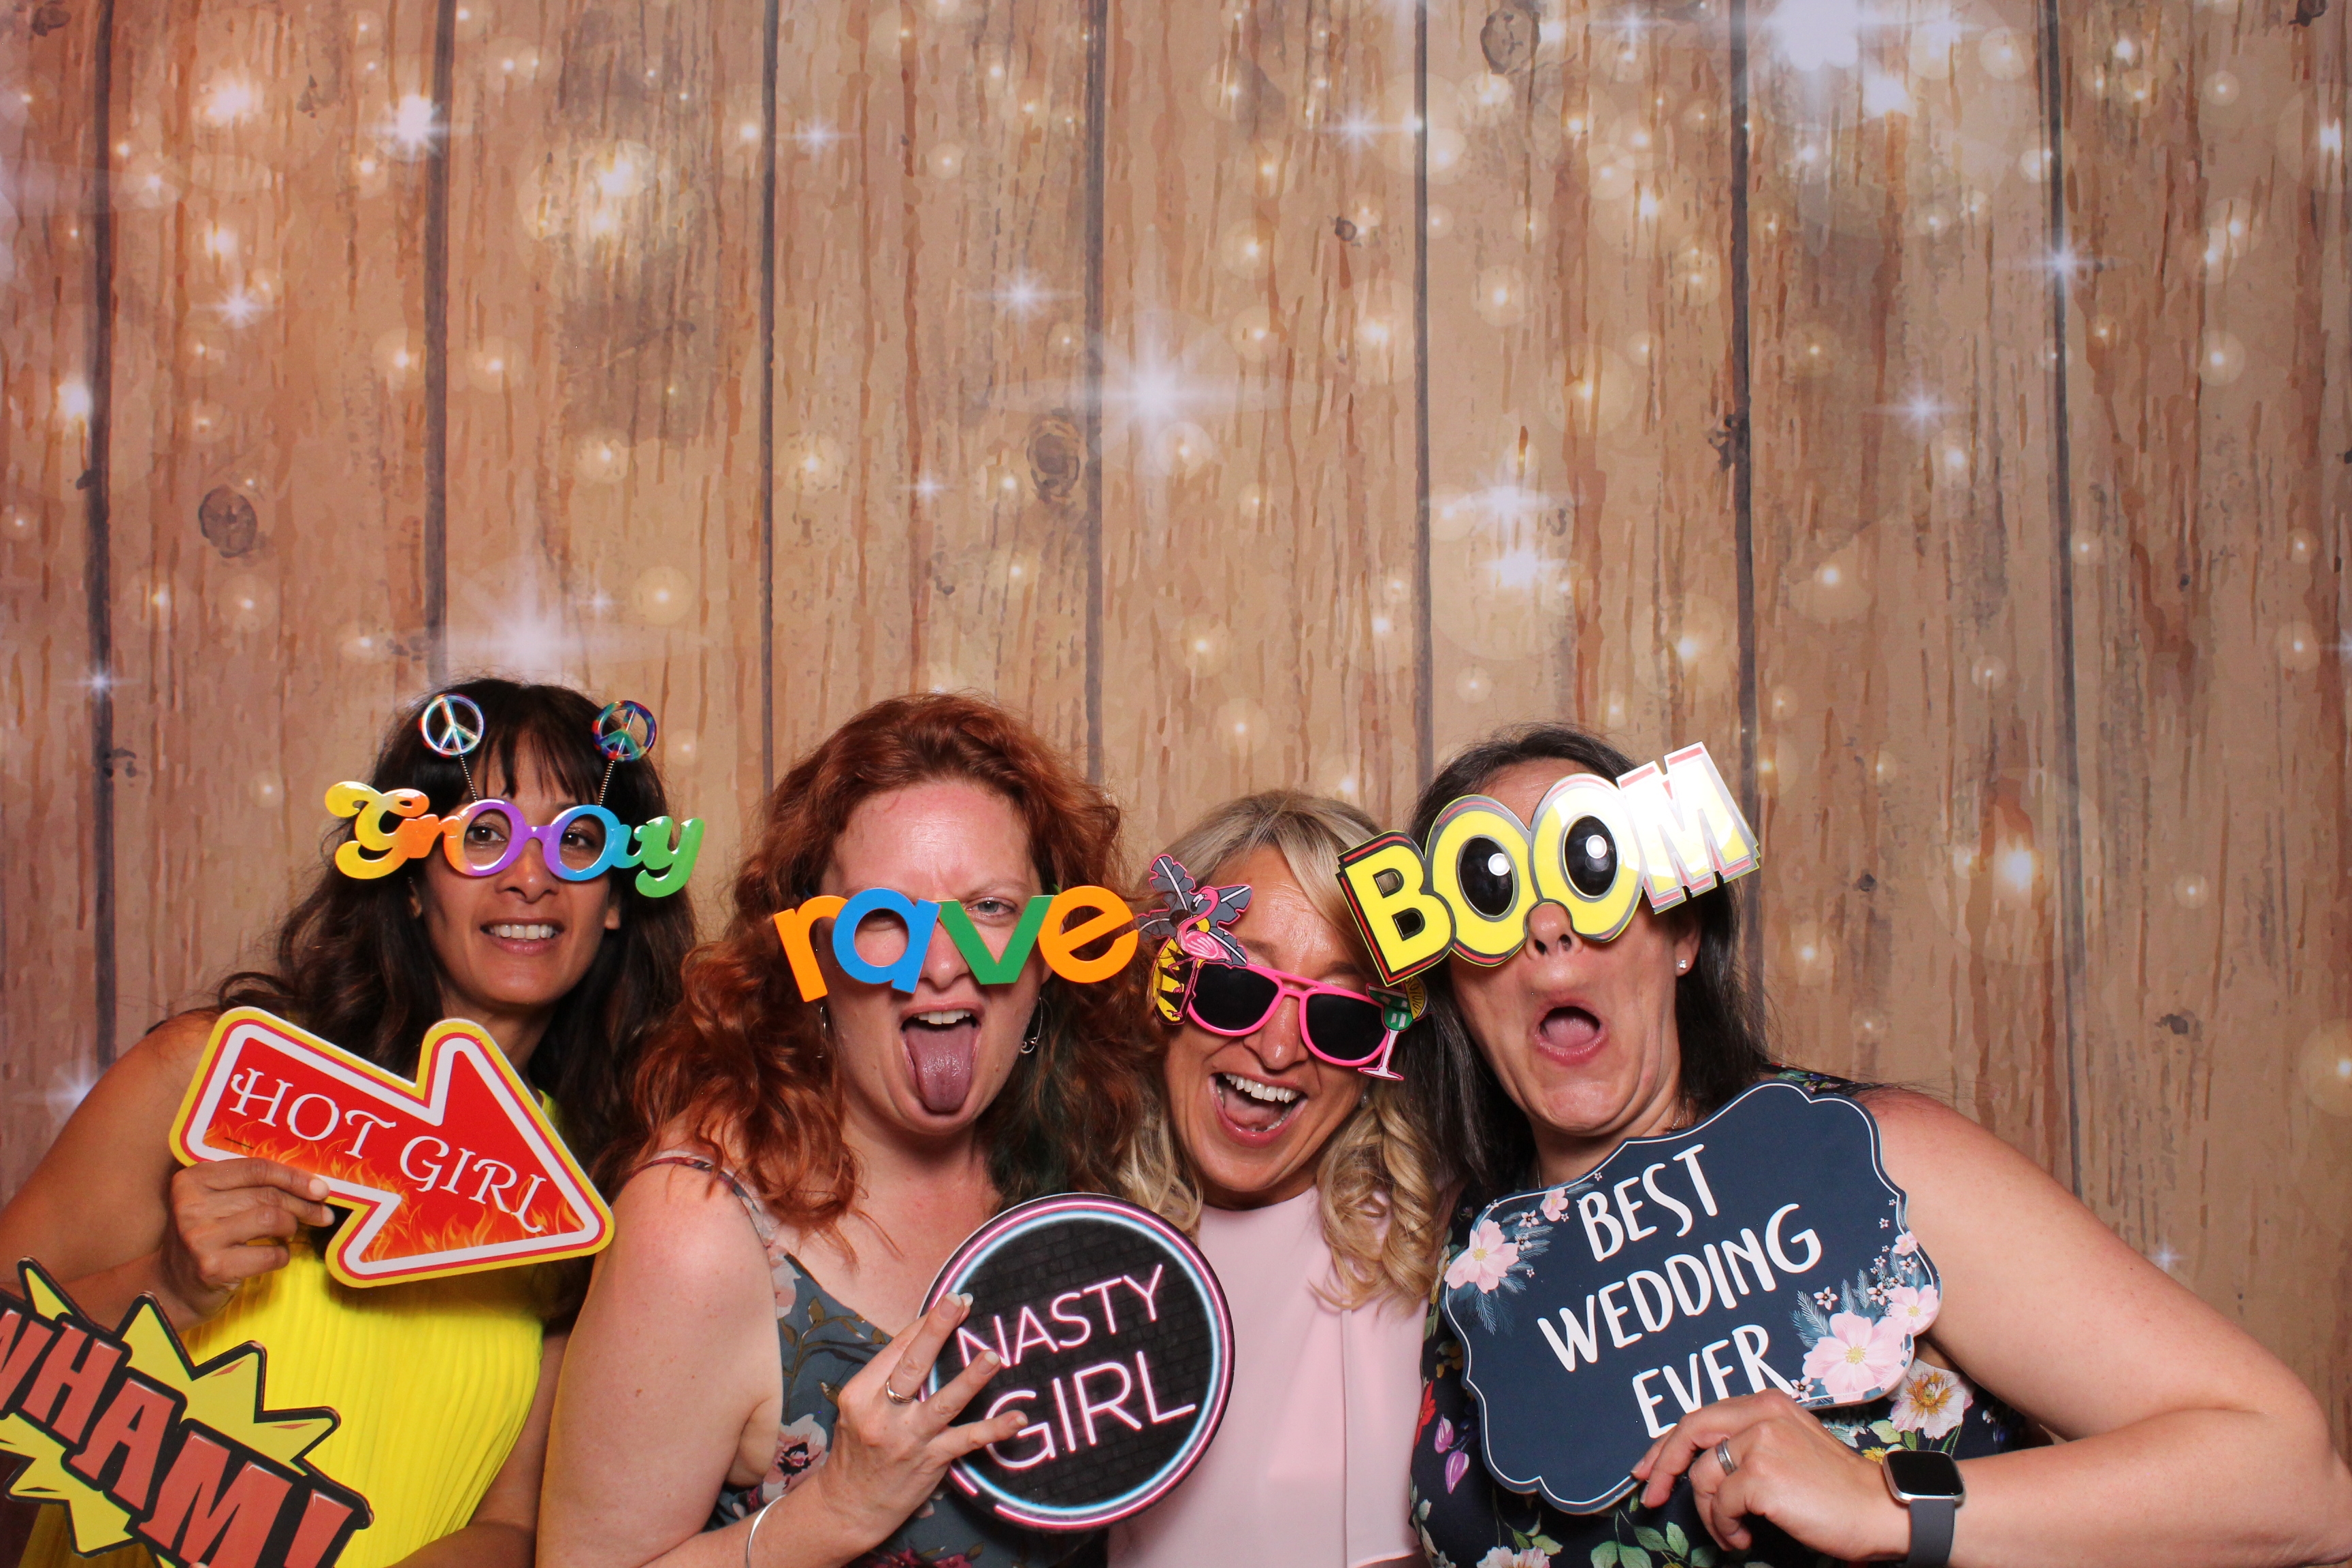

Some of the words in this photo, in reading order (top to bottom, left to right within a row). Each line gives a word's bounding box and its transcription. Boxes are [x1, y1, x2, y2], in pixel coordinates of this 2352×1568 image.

[325, 781, 705, 898] Groovy
[1335, 740, 1760, 986] BOOM
[773, 885, 1139, 1002] rave
[228, 1067, 397, 1160] HOT
[398, 1135, 547, 1234] GIRL
[1578, 1144, 1718, 1262] BEST
[956, 1263, 1163, 1369] NASTY
[1537, 1203, 1822, 1372] WEDDING
[983, 1350, 1196, 1470] GIRL
[1632, 1324, 1795, 1439] EVER
